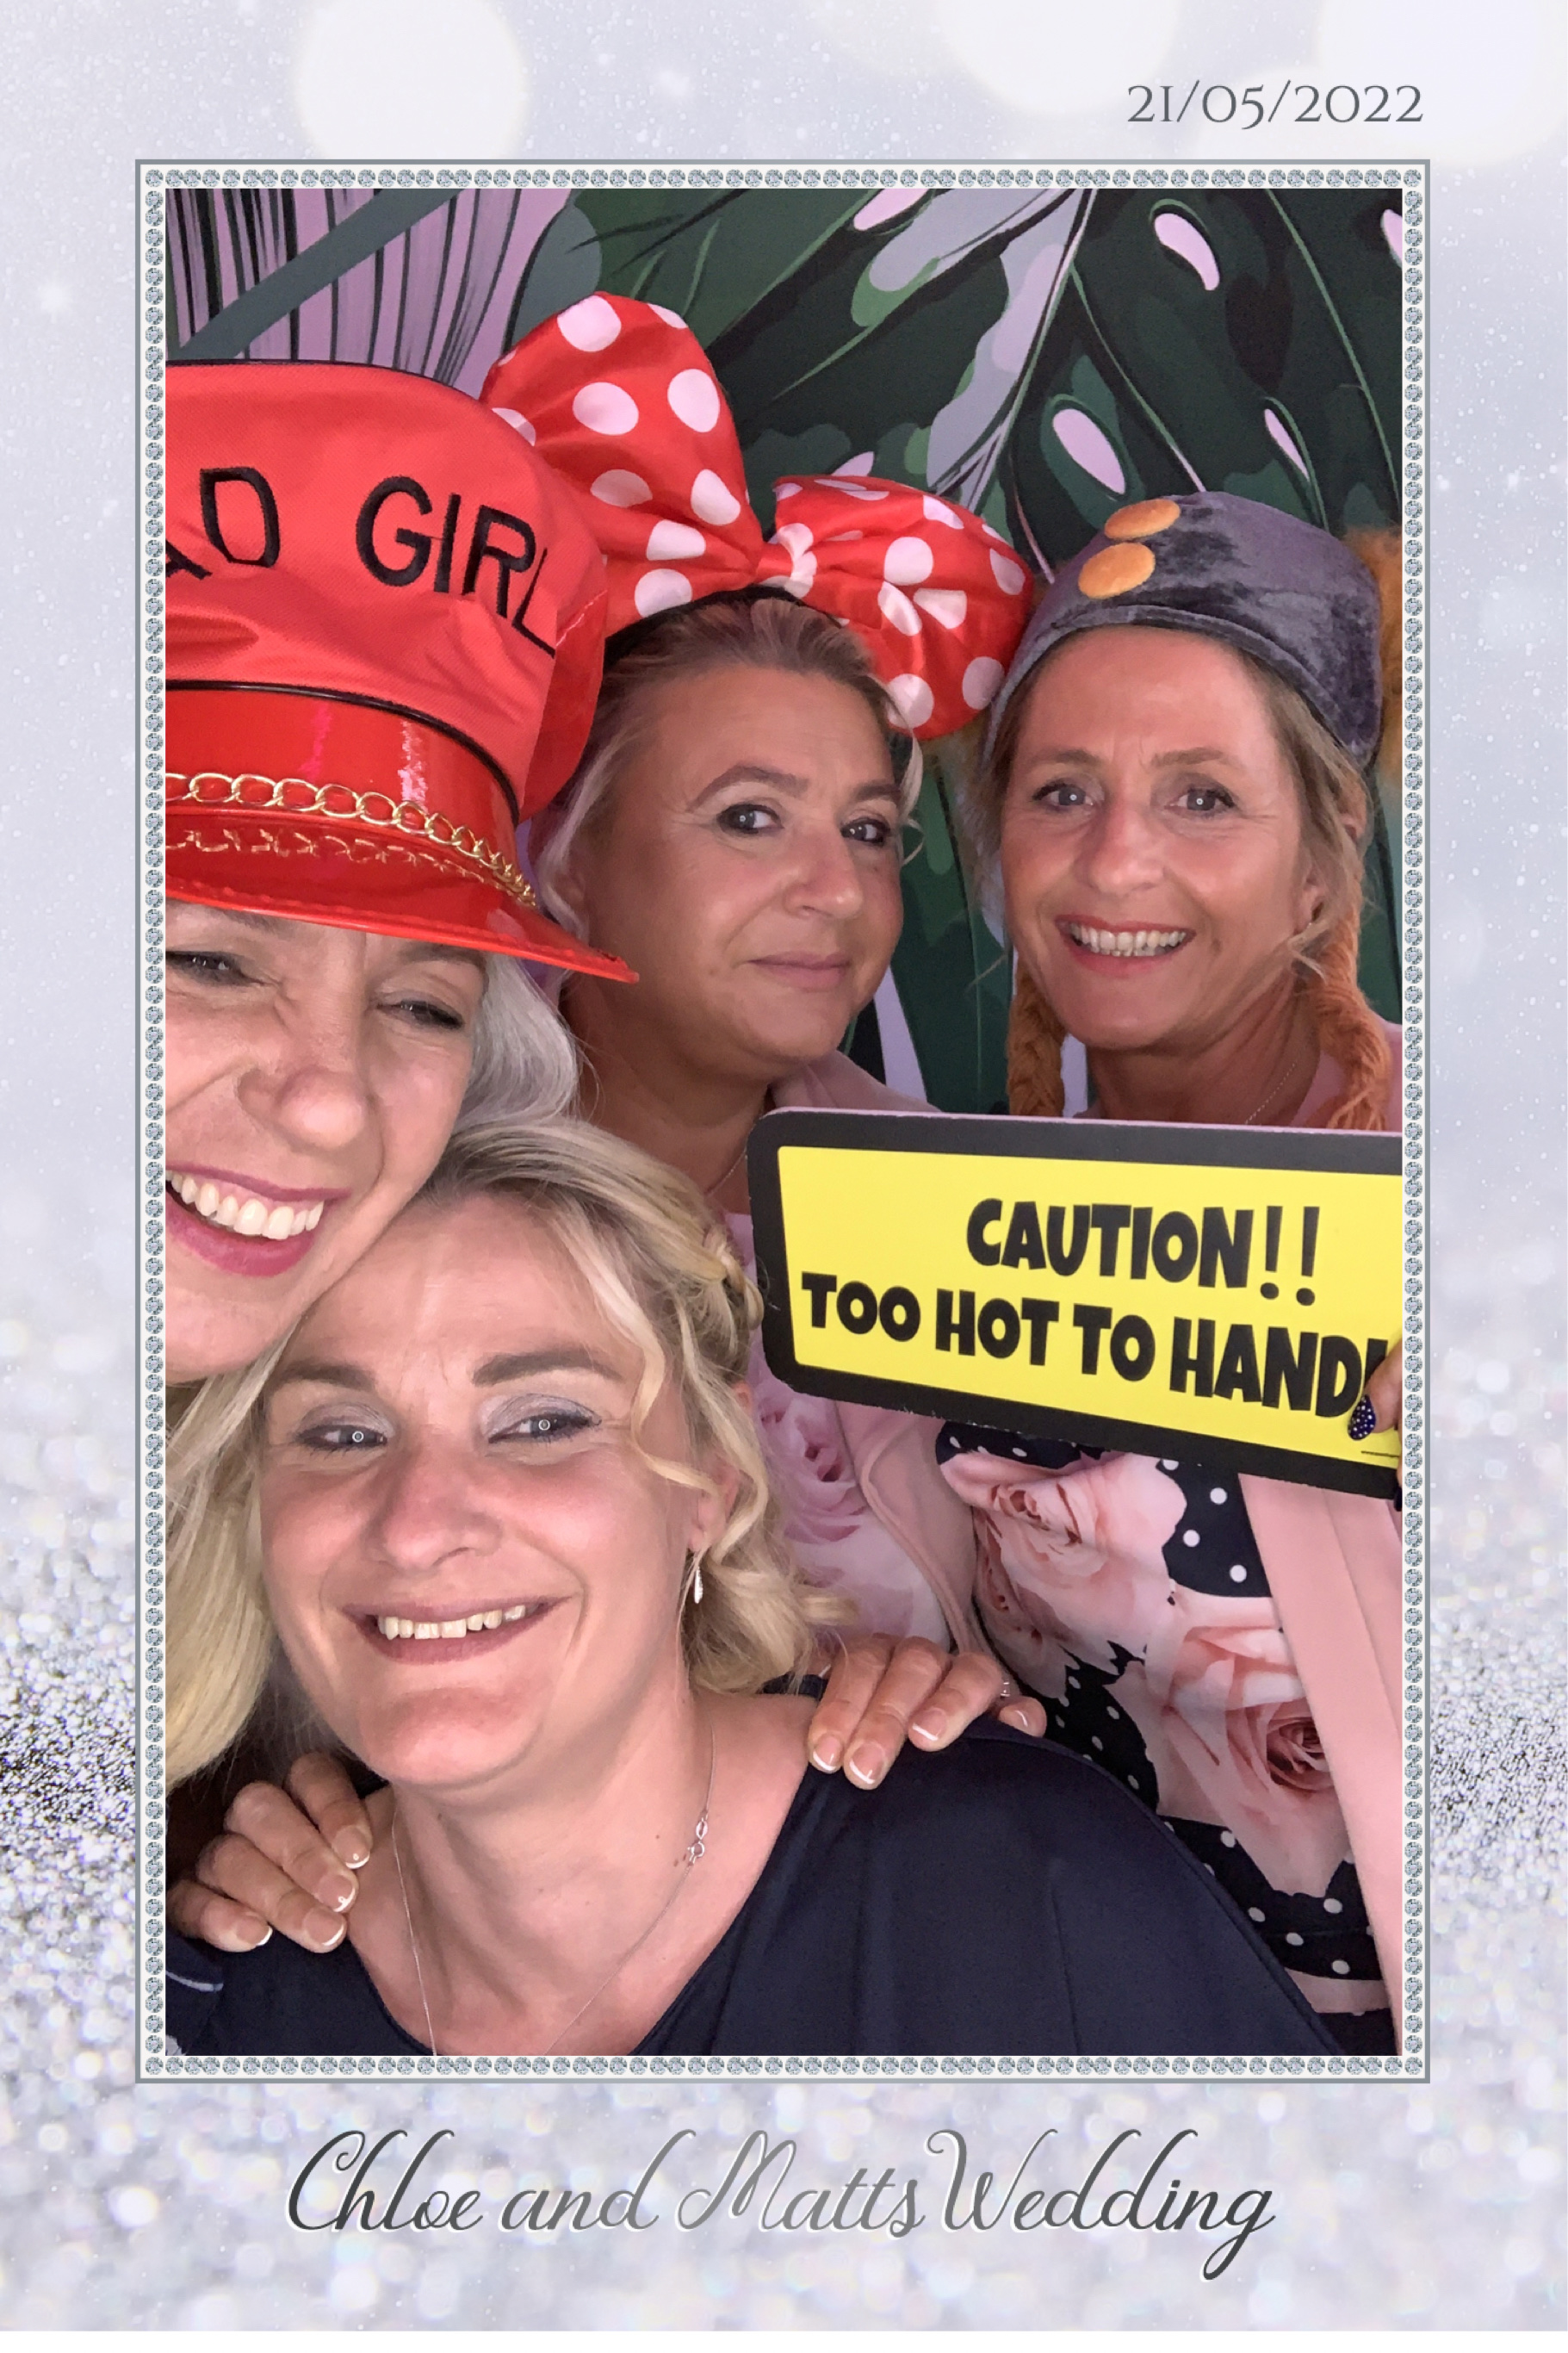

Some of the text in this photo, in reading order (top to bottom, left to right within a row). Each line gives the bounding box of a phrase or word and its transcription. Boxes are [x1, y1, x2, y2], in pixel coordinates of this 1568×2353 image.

[356, 475, 556, 659] GIRL
[966, 1198, 1320, 1307] CAUTION!!
[802, 1271, 920, 1343] TOO
[935, 1289, 1059, 1366] HOT
[1073, 1304, 1156, 1381] TO
